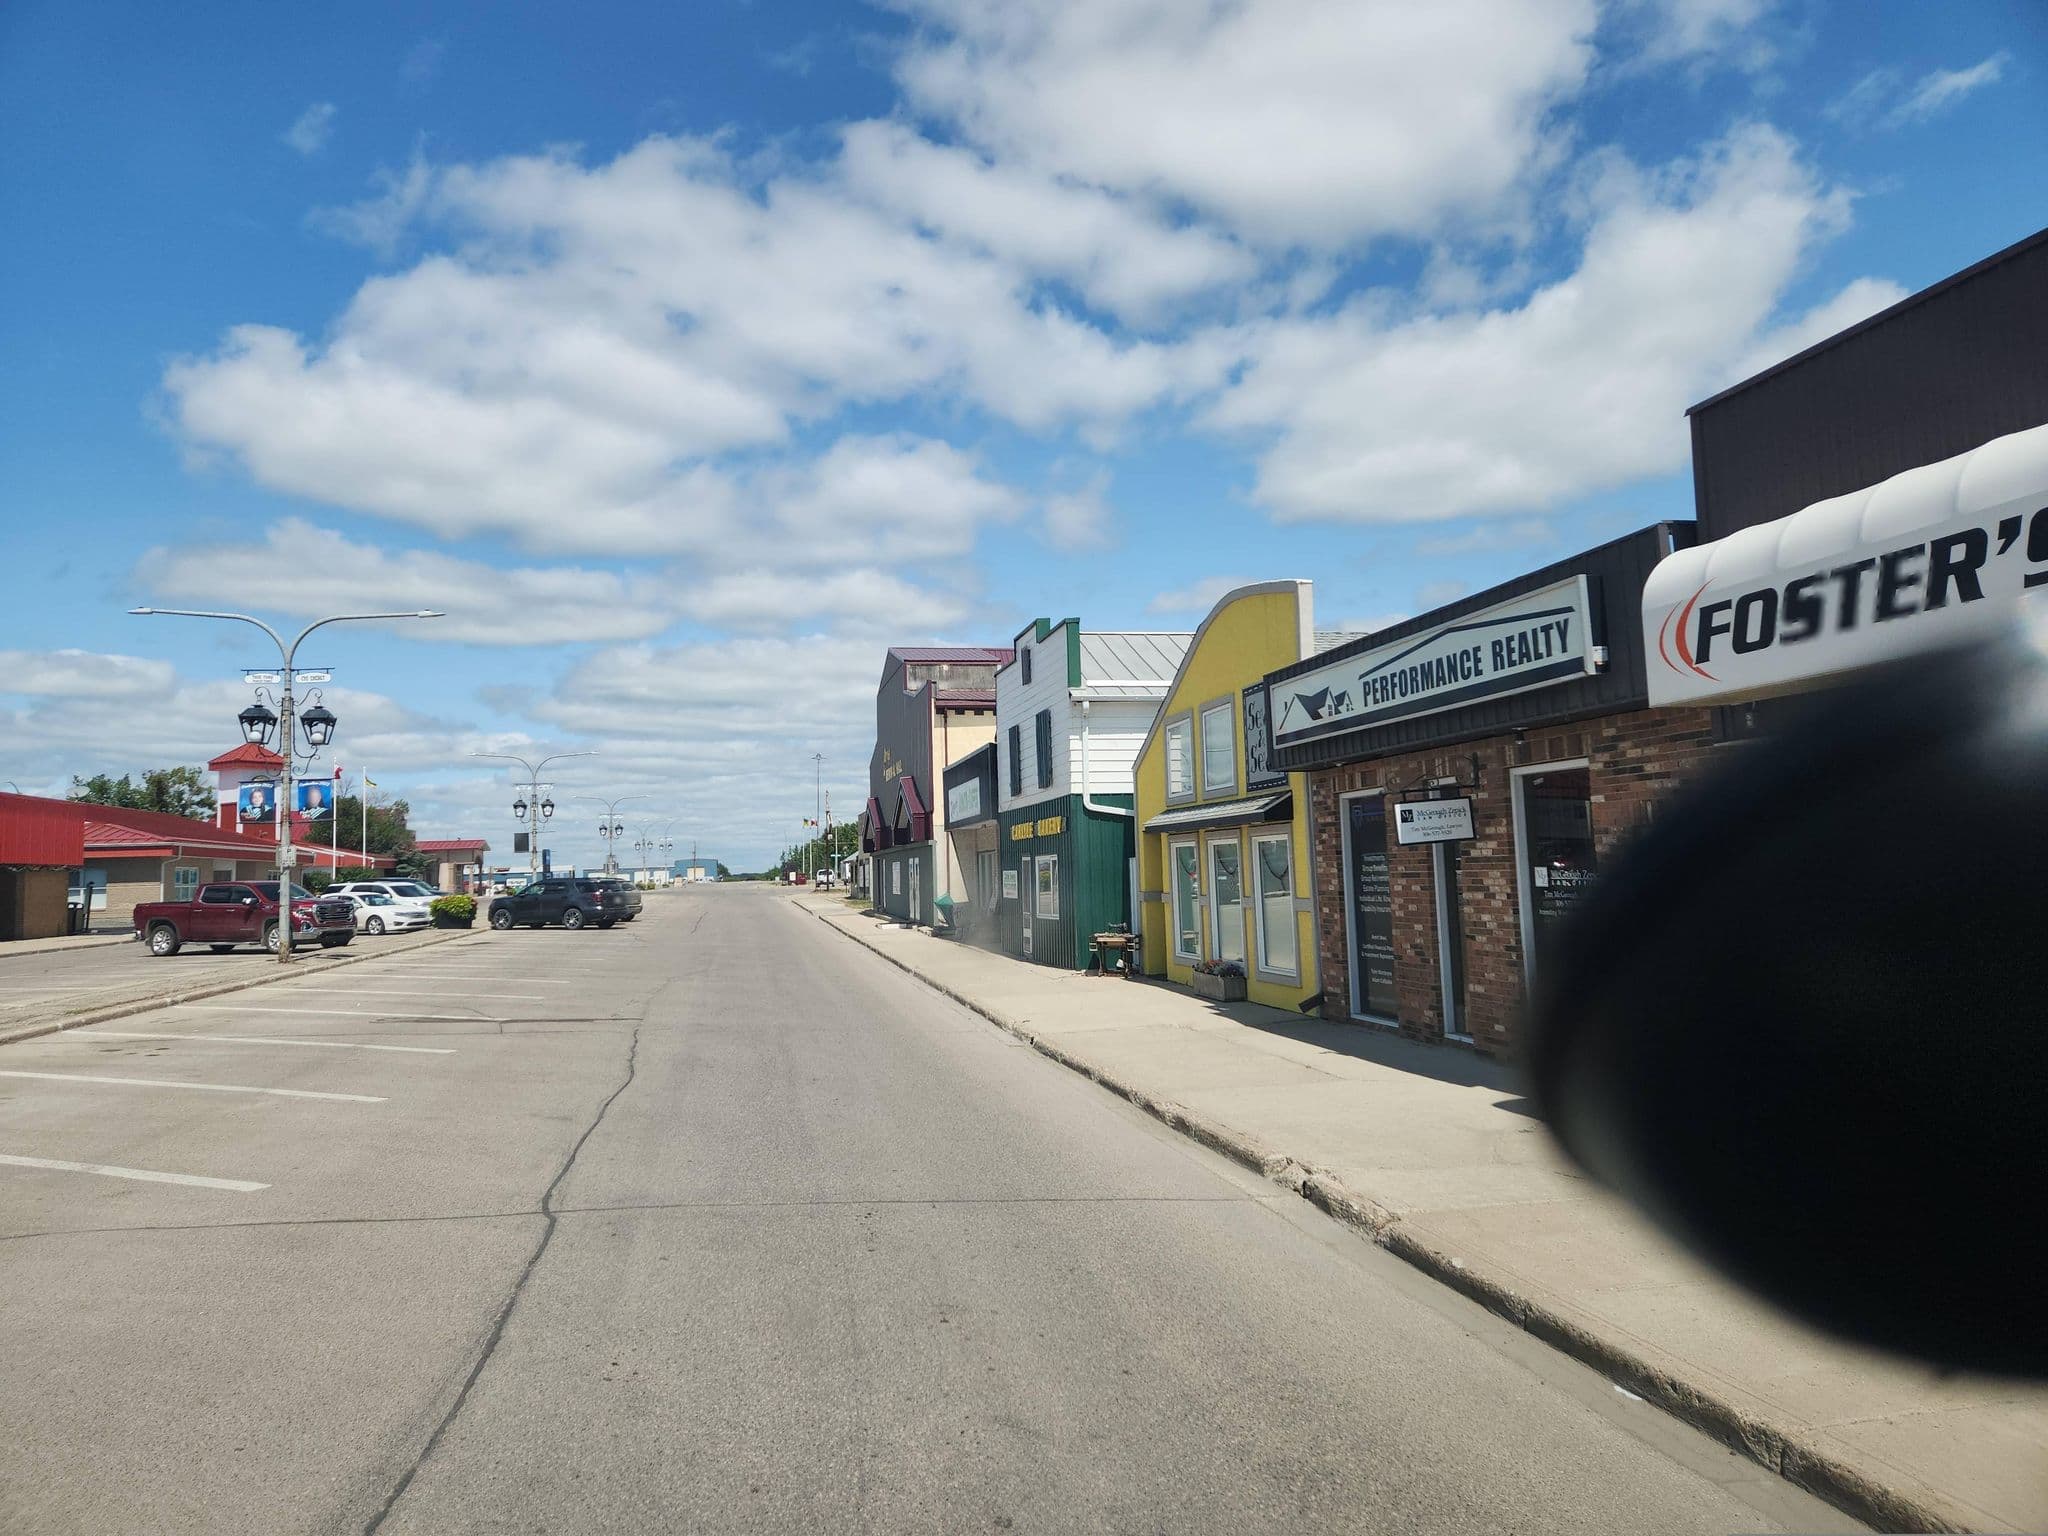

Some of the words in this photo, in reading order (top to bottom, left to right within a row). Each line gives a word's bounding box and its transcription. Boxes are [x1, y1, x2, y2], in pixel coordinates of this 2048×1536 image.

[1363, 645, 1484, 708] PERFORMANCE
[1492, 618, 1571, 672] REALTY
[1248, 701, 1266, 731] Se
[1250, 744, 1271, 774] Se
